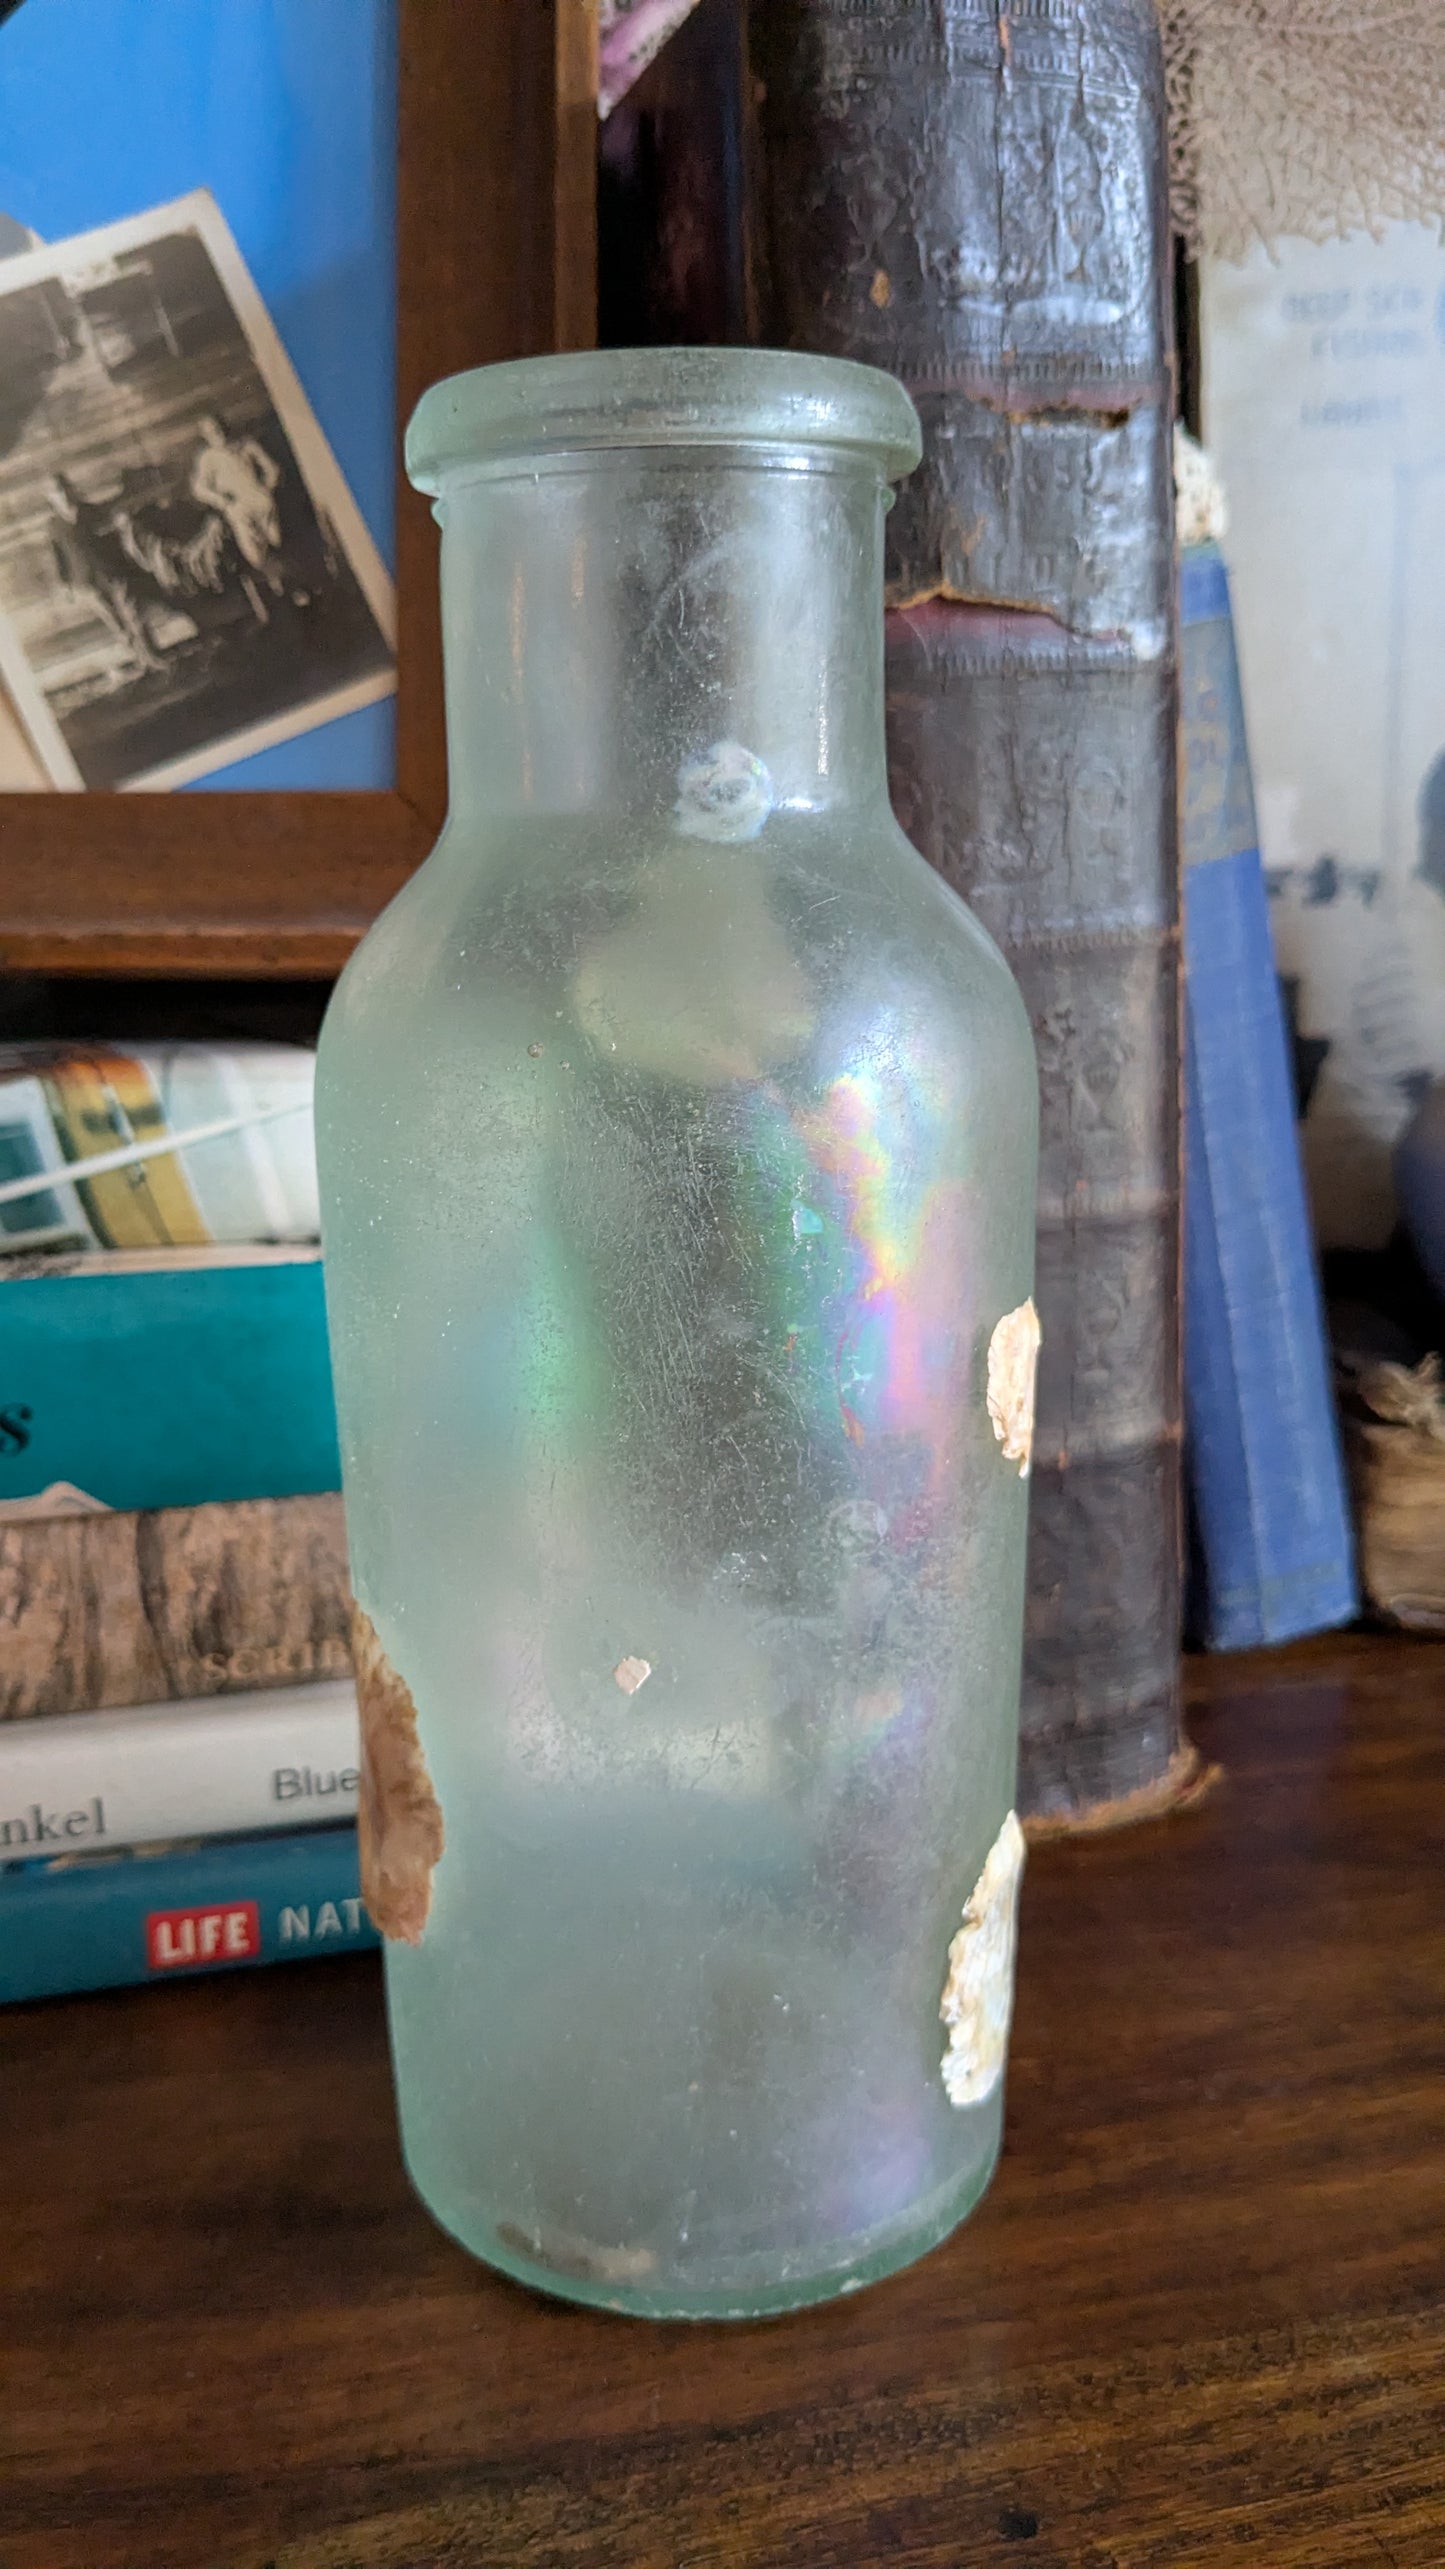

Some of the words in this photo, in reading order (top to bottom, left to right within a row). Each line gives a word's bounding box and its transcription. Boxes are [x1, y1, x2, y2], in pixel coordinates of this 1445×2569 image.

[273, 1766, 359, 1800] Blue
[0, 1797, 106, 1846] nkel
[155, 1911, 250, 1962] LIFE
